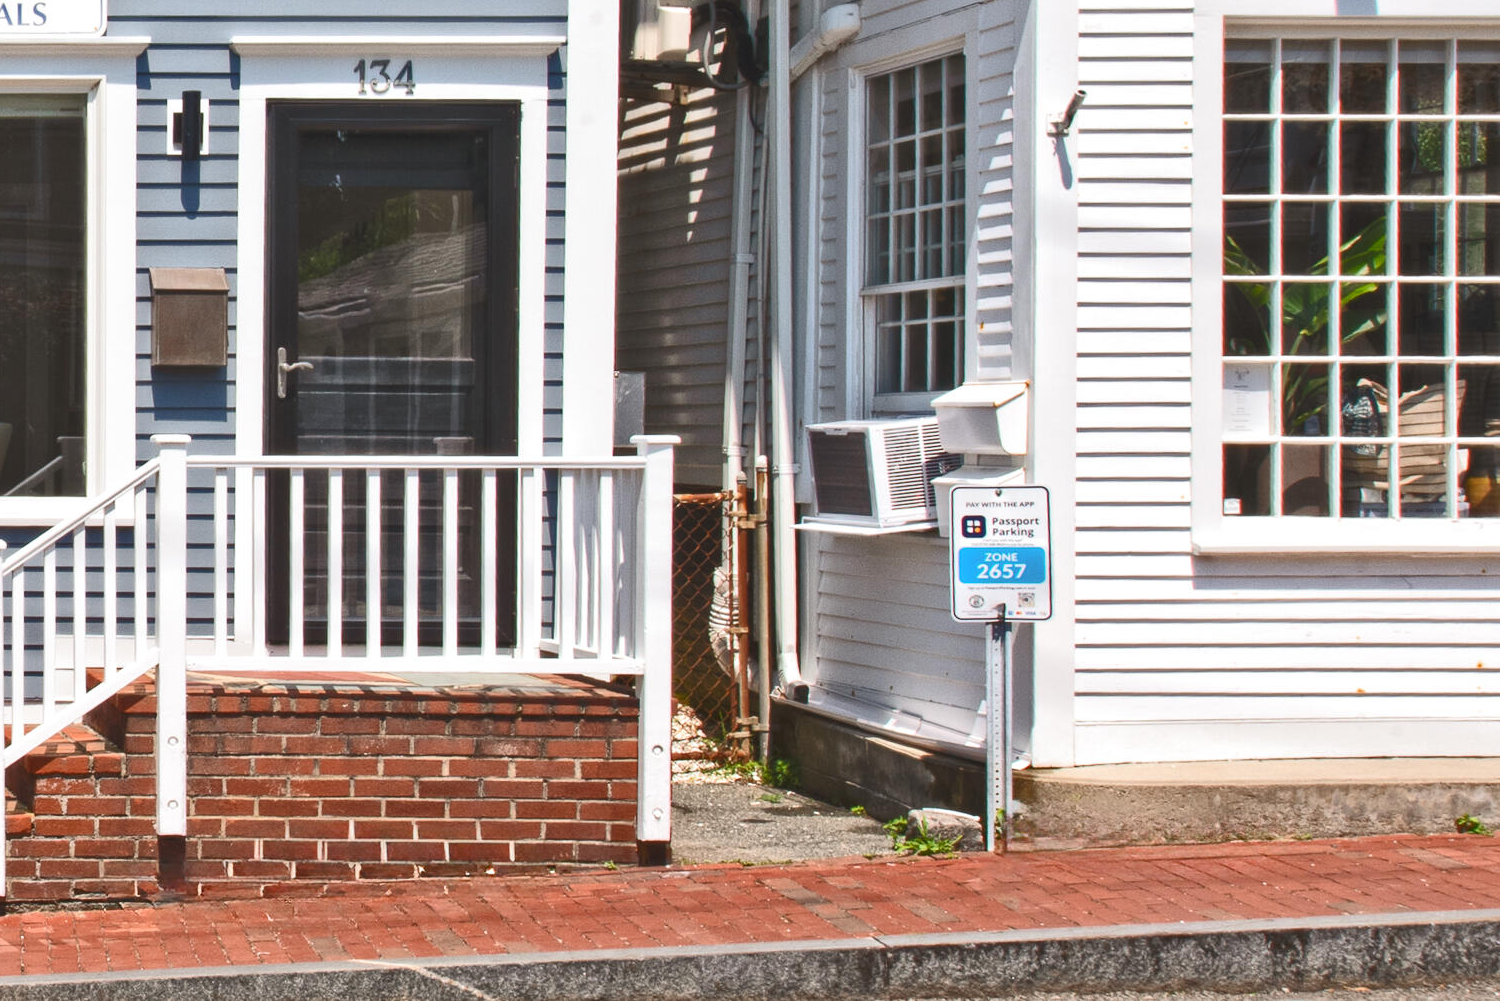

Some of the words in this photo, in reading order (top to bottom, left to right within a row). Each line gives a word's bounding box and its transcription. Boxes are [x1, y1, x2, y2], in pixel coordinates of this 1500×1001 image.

[353, 59, 416, 95] 134
[992, 517, 1040, 527] Passport
[992, 527, 1035, 538] Parking
[984, 553, 1018, 562] ZONE
[977, 564, 1027, 579] 2657
